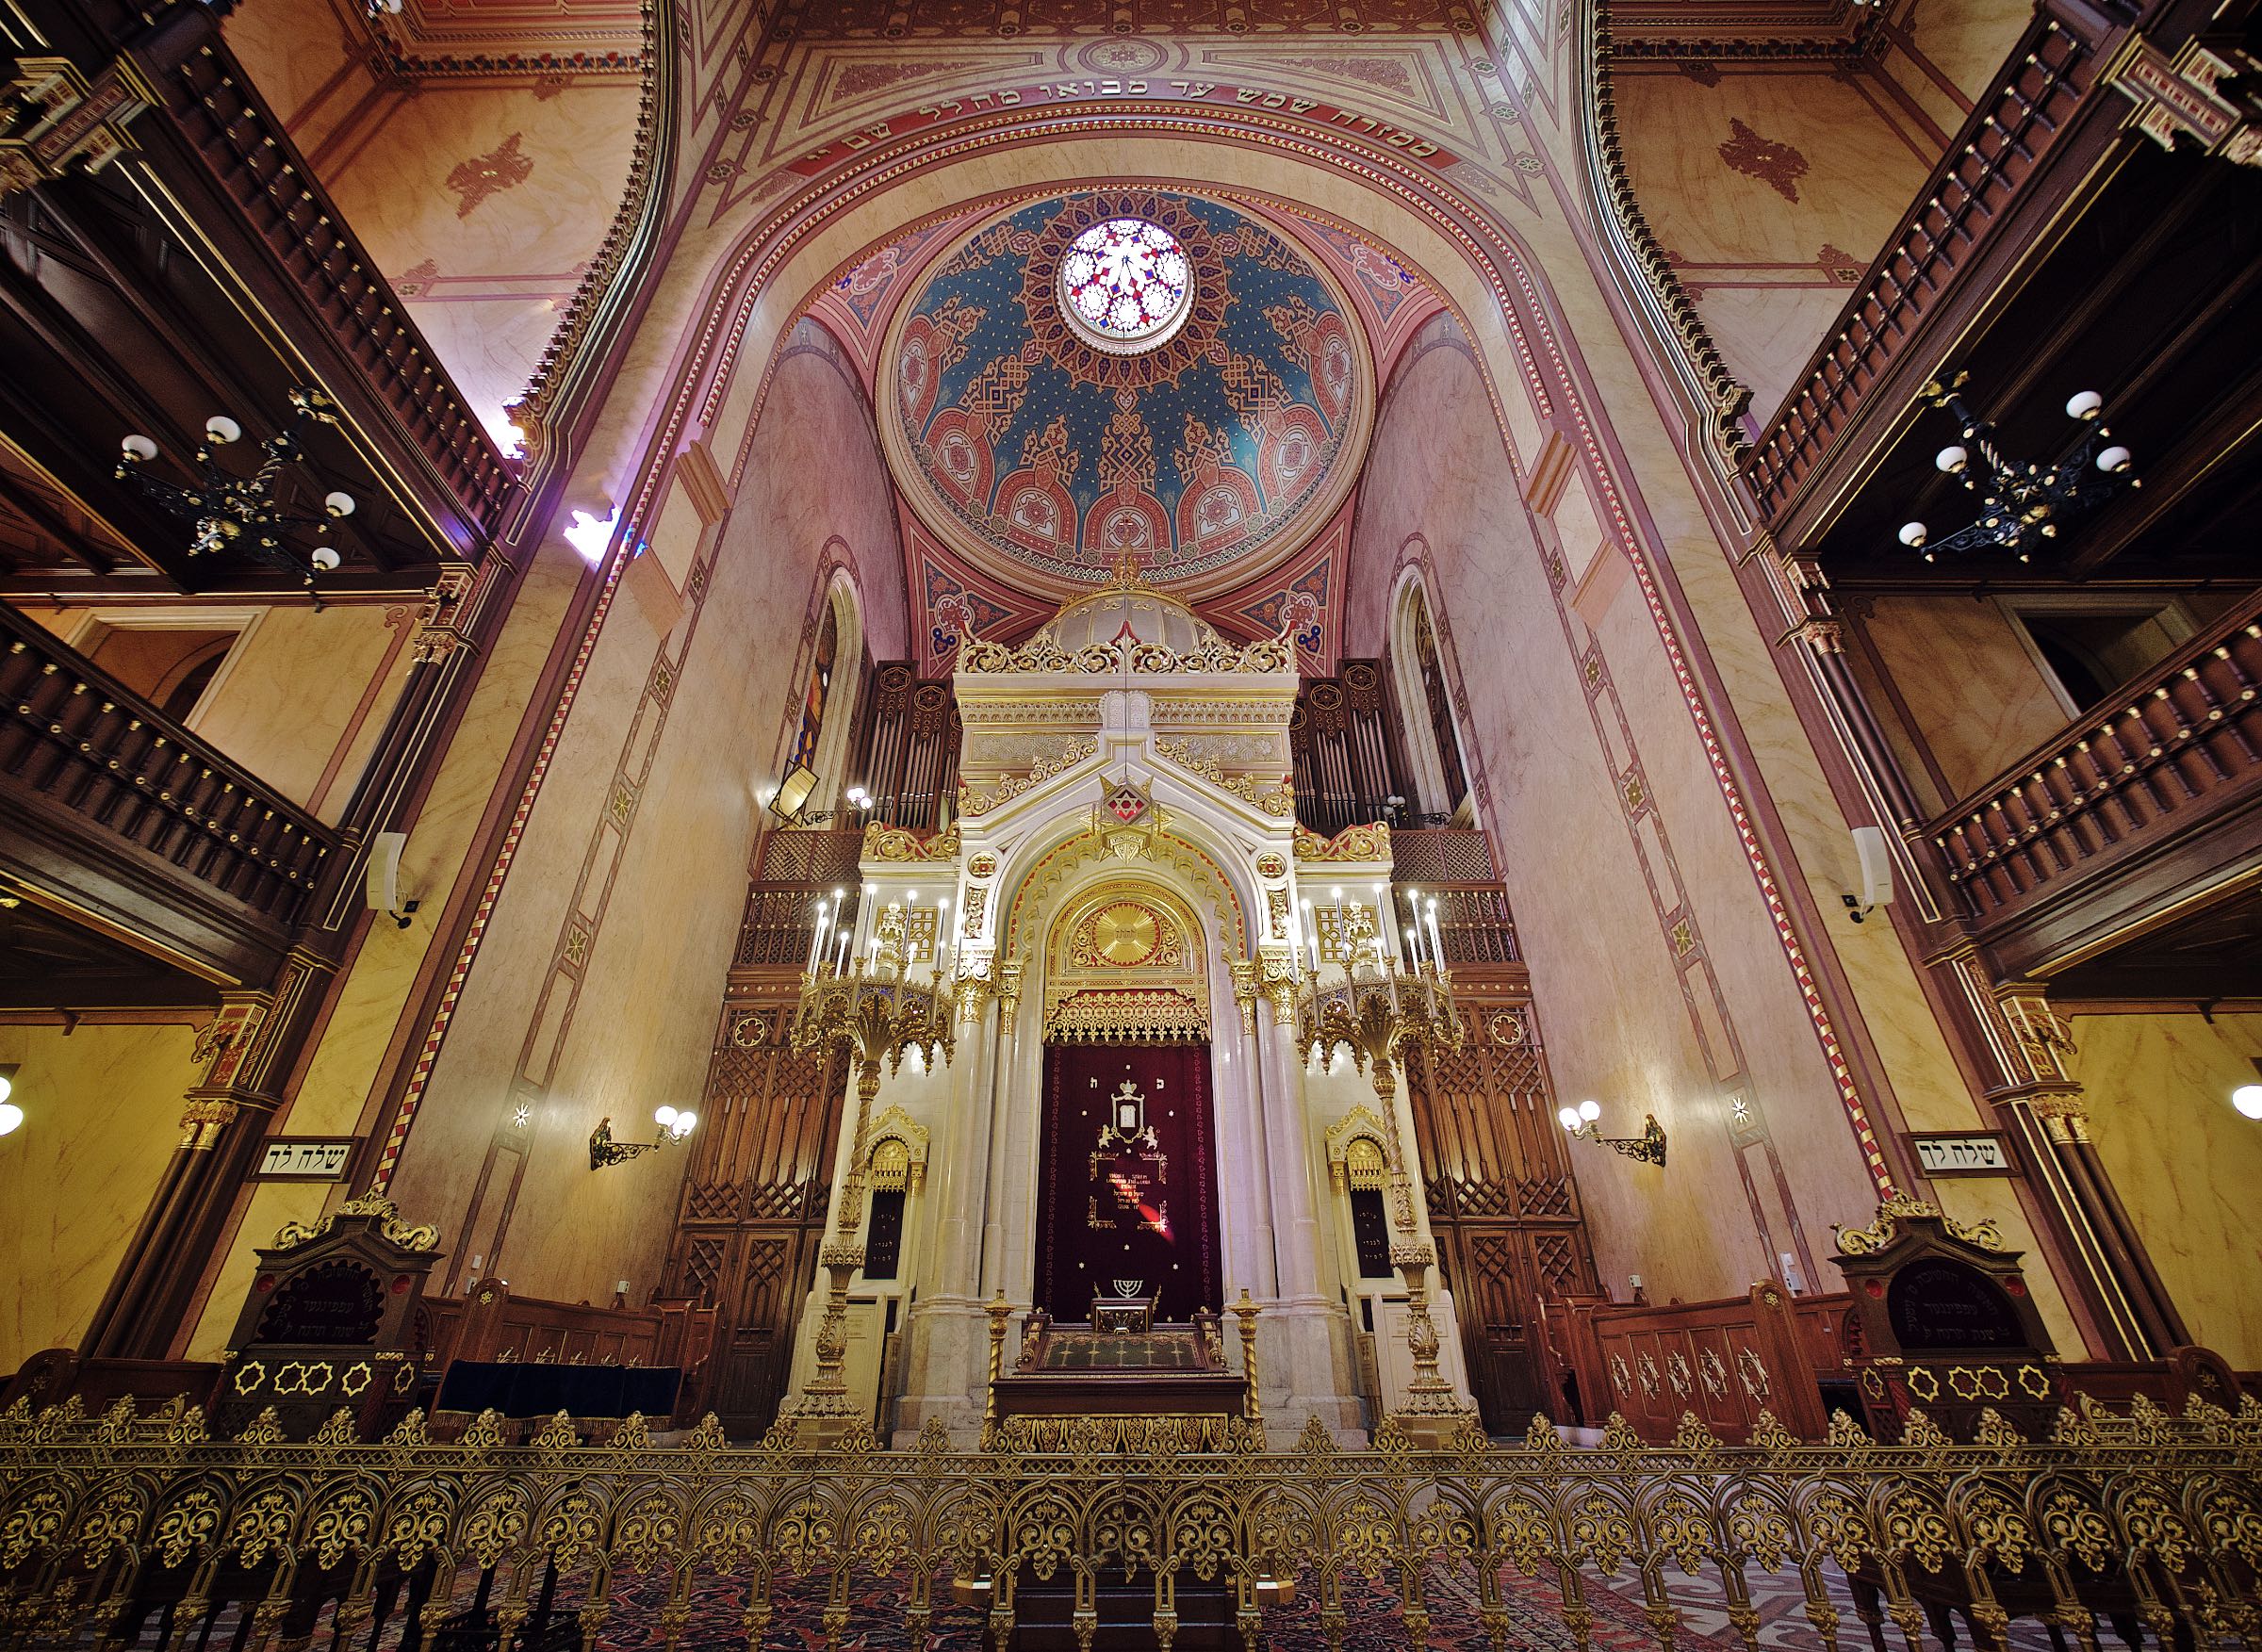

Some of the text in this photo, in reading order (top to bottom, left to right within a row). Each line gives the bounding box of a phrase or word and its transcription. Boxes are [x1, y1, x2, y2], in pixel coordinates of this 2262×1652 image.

[806, 80, 1439, 161] ממזרח שמש עד מבואו מהלל שם יי
[269, 1144, 292, 1172] לך
[1920, 1139, 1946, 1167] לך
